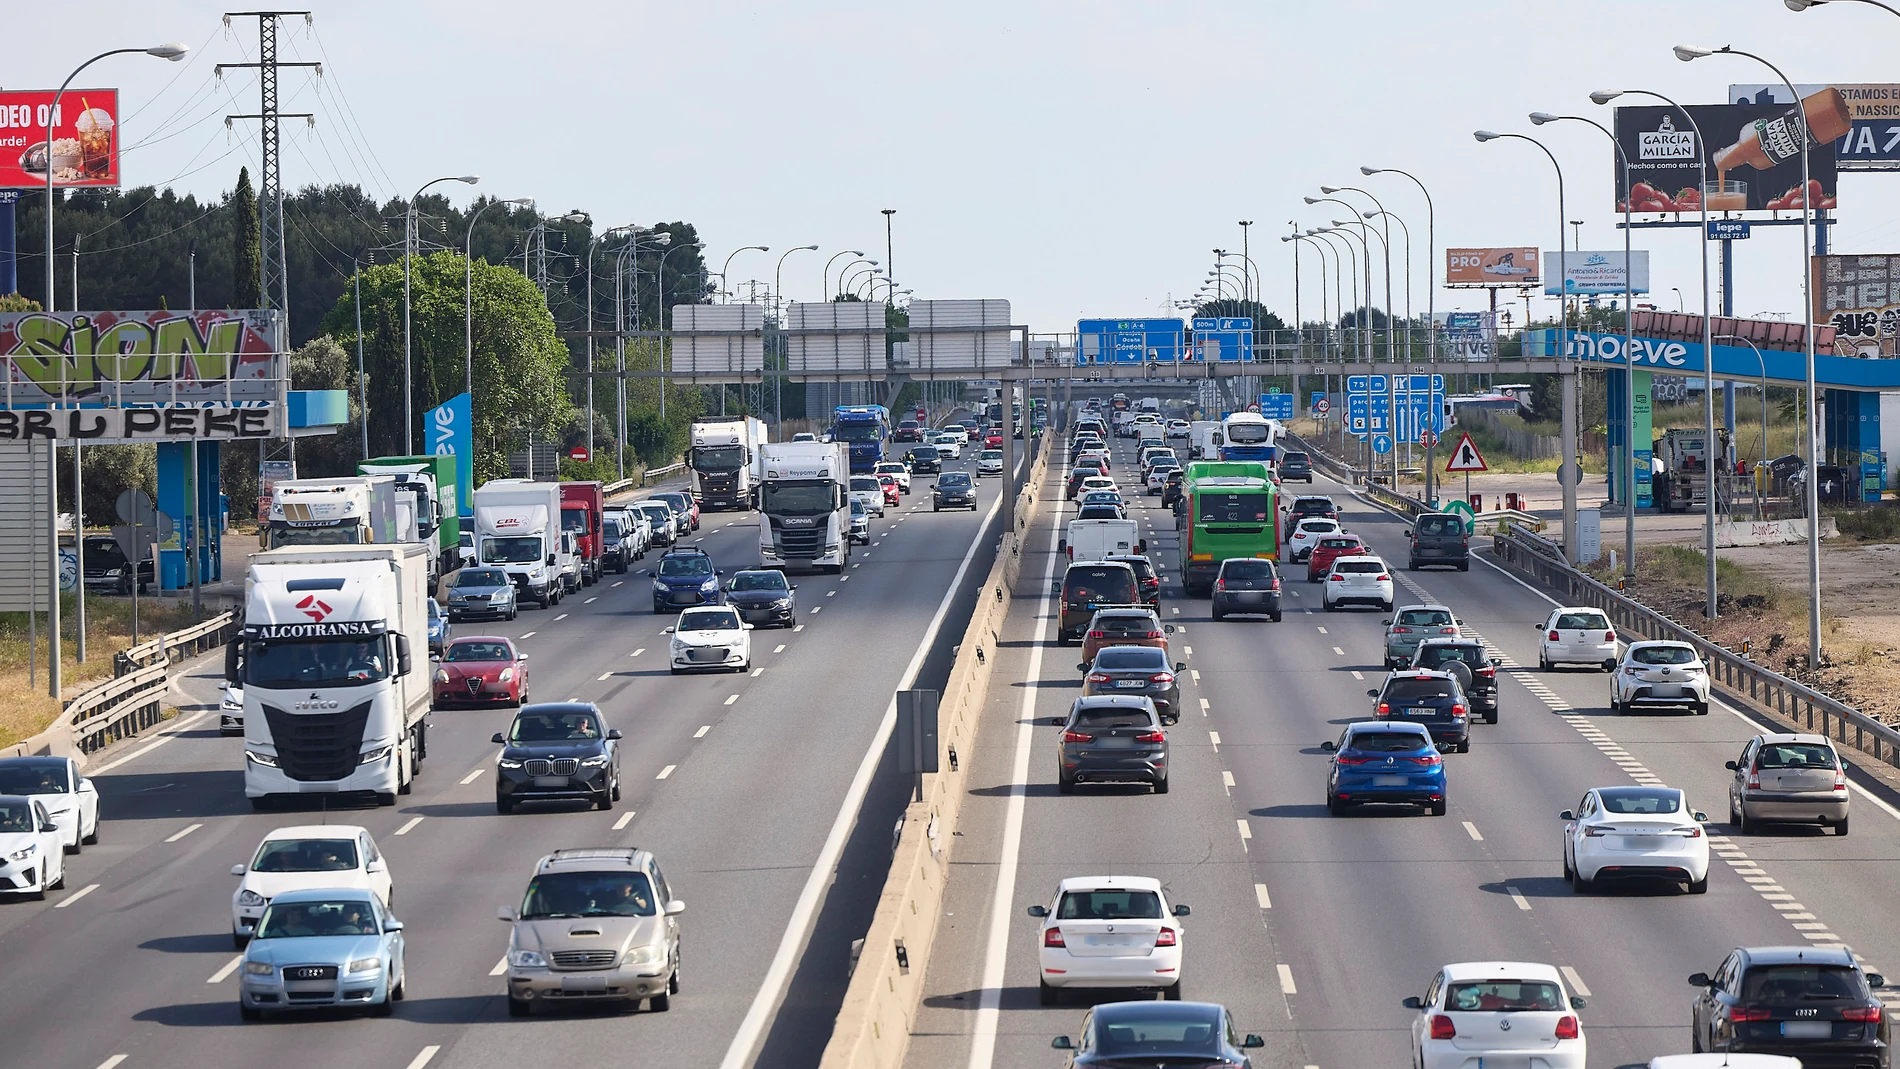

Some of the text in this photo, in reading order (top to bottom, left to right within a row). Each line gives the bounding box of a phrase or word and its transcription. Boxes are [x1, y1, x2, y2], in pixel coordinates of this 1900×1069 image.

[1838, 89, 1900, 99] STAMOS E
[1643, 133, 1690, 145] GARCÍA
[1643, 145, 1691, 156] MILLÁN
[1716, 223, 1742, 232] iepe
[1450, 256, 1481, 267] PRO
[1566, 333, 1687, 366] moeve
[259, 622, 371, 639] ALCOTRANSA
[295, 700, 338, 710] IVECO
